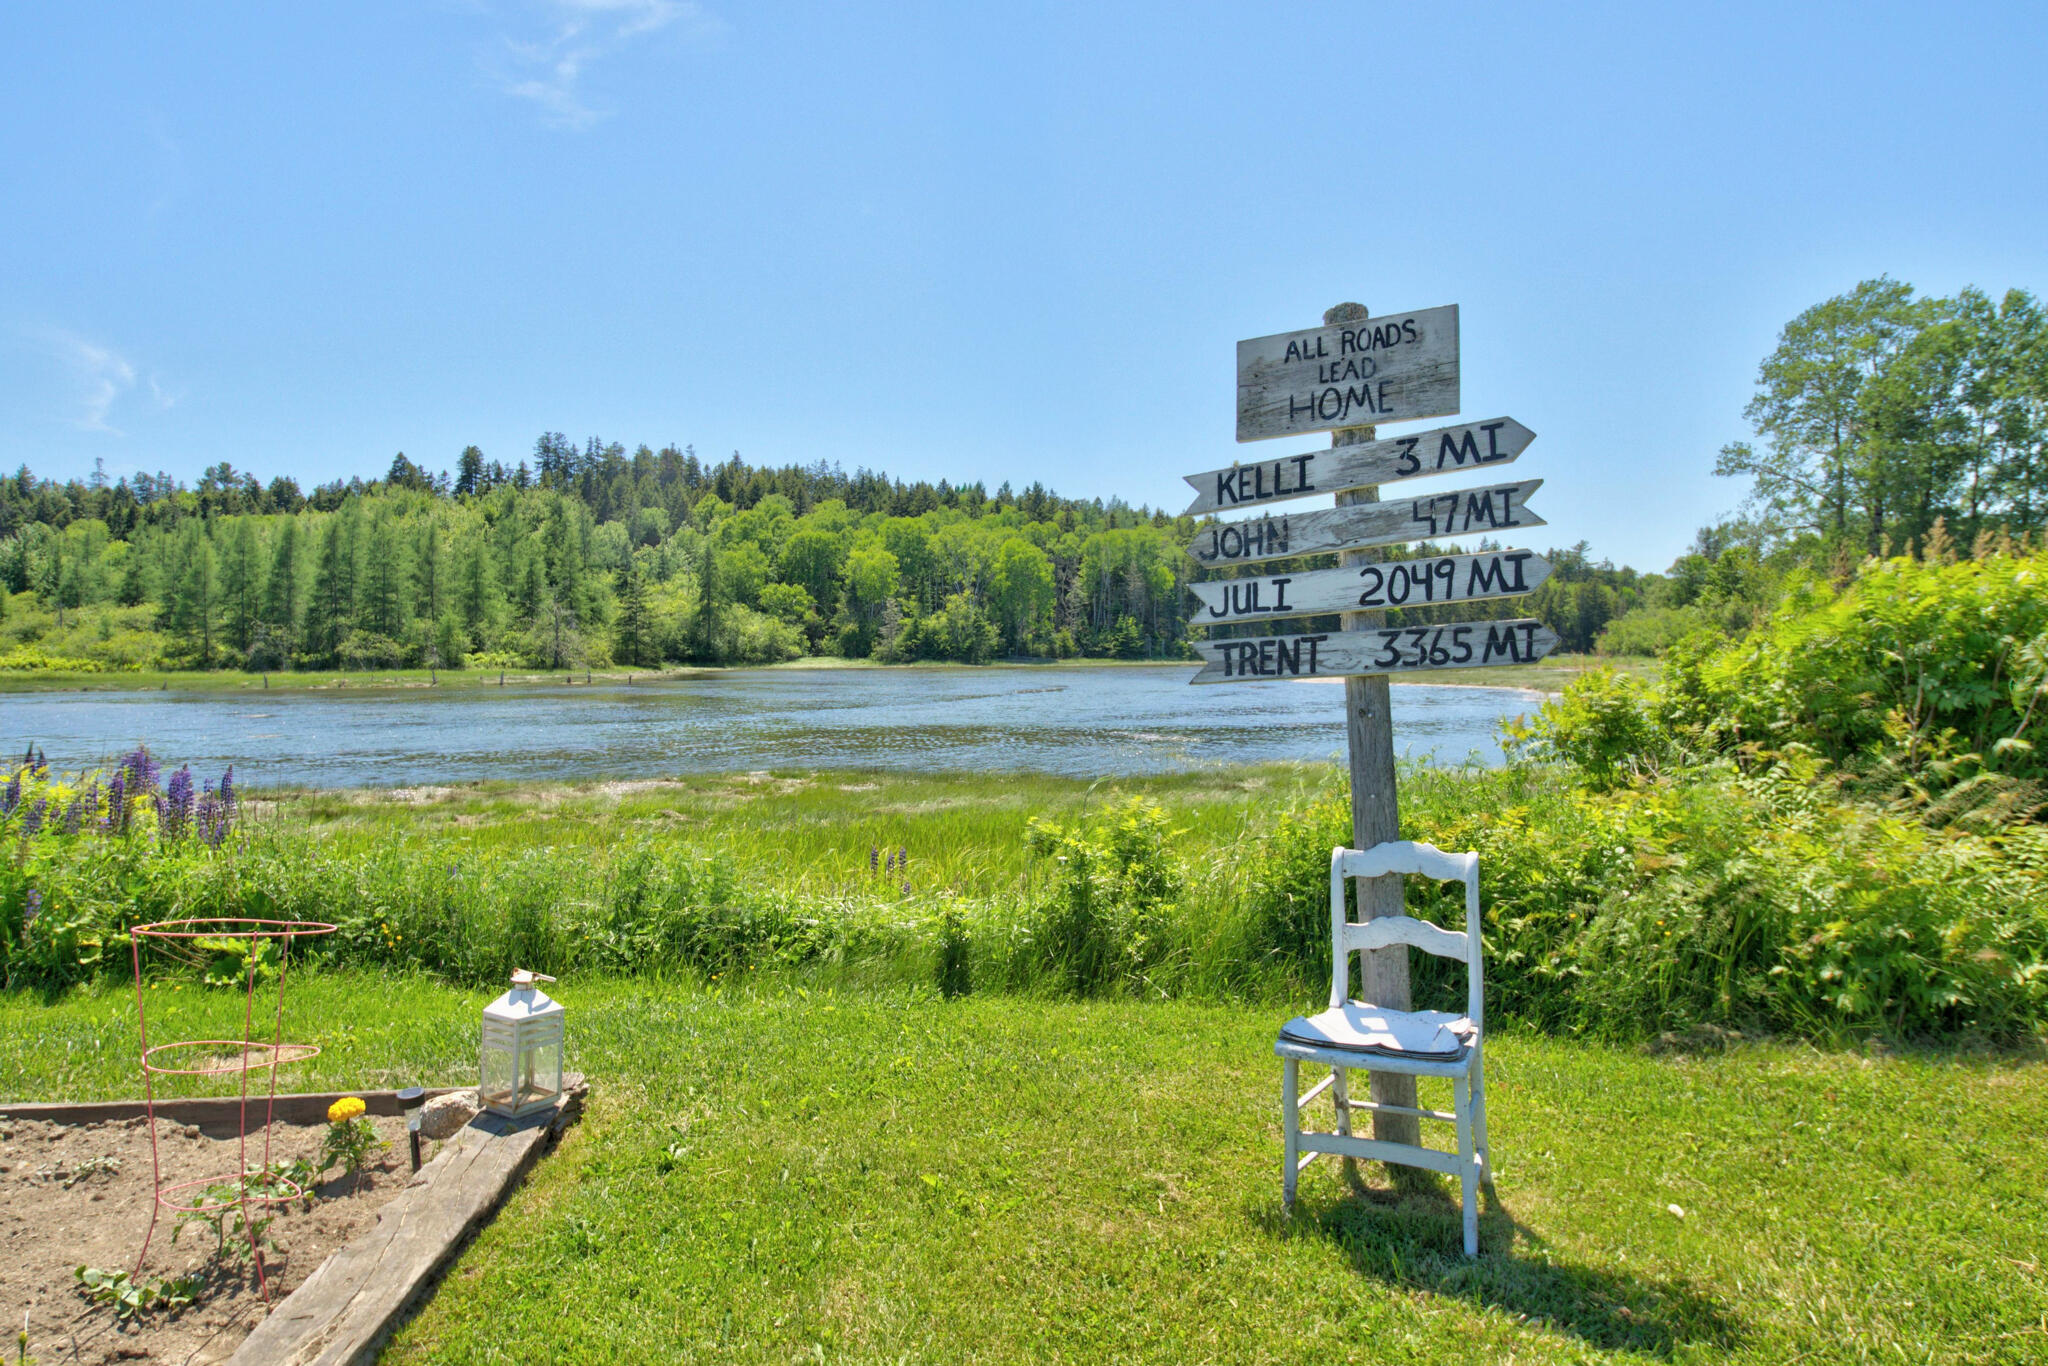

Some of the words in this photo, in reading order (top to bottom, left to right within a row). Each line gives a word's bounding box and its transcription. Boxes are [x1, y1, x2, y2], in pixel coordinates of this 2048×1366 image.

[1284, 335, 1329, 363] ALL
[1341, 318, 1416, 356] ROADS
[1319, 356, 1377, 384] LEAD
[1289, 380, 1394, 422] HOME
[1217, 454, 1315, 506] KELLI
[1395, 437, 1420, 476] 3
[1436, 421, 1508, 470] MI
[1199, 518, 1289, 561] JOHN
[1208, 577, 1293, 618] JULI
[1358, 558, 1455, 607] 2049
[1466, 553, 1532, 597] MI
[1213, 634, 1329, 677] TRENT
[1373, 626, 1473, 668] 3365
[1481, 622, 1543, 664] MI
